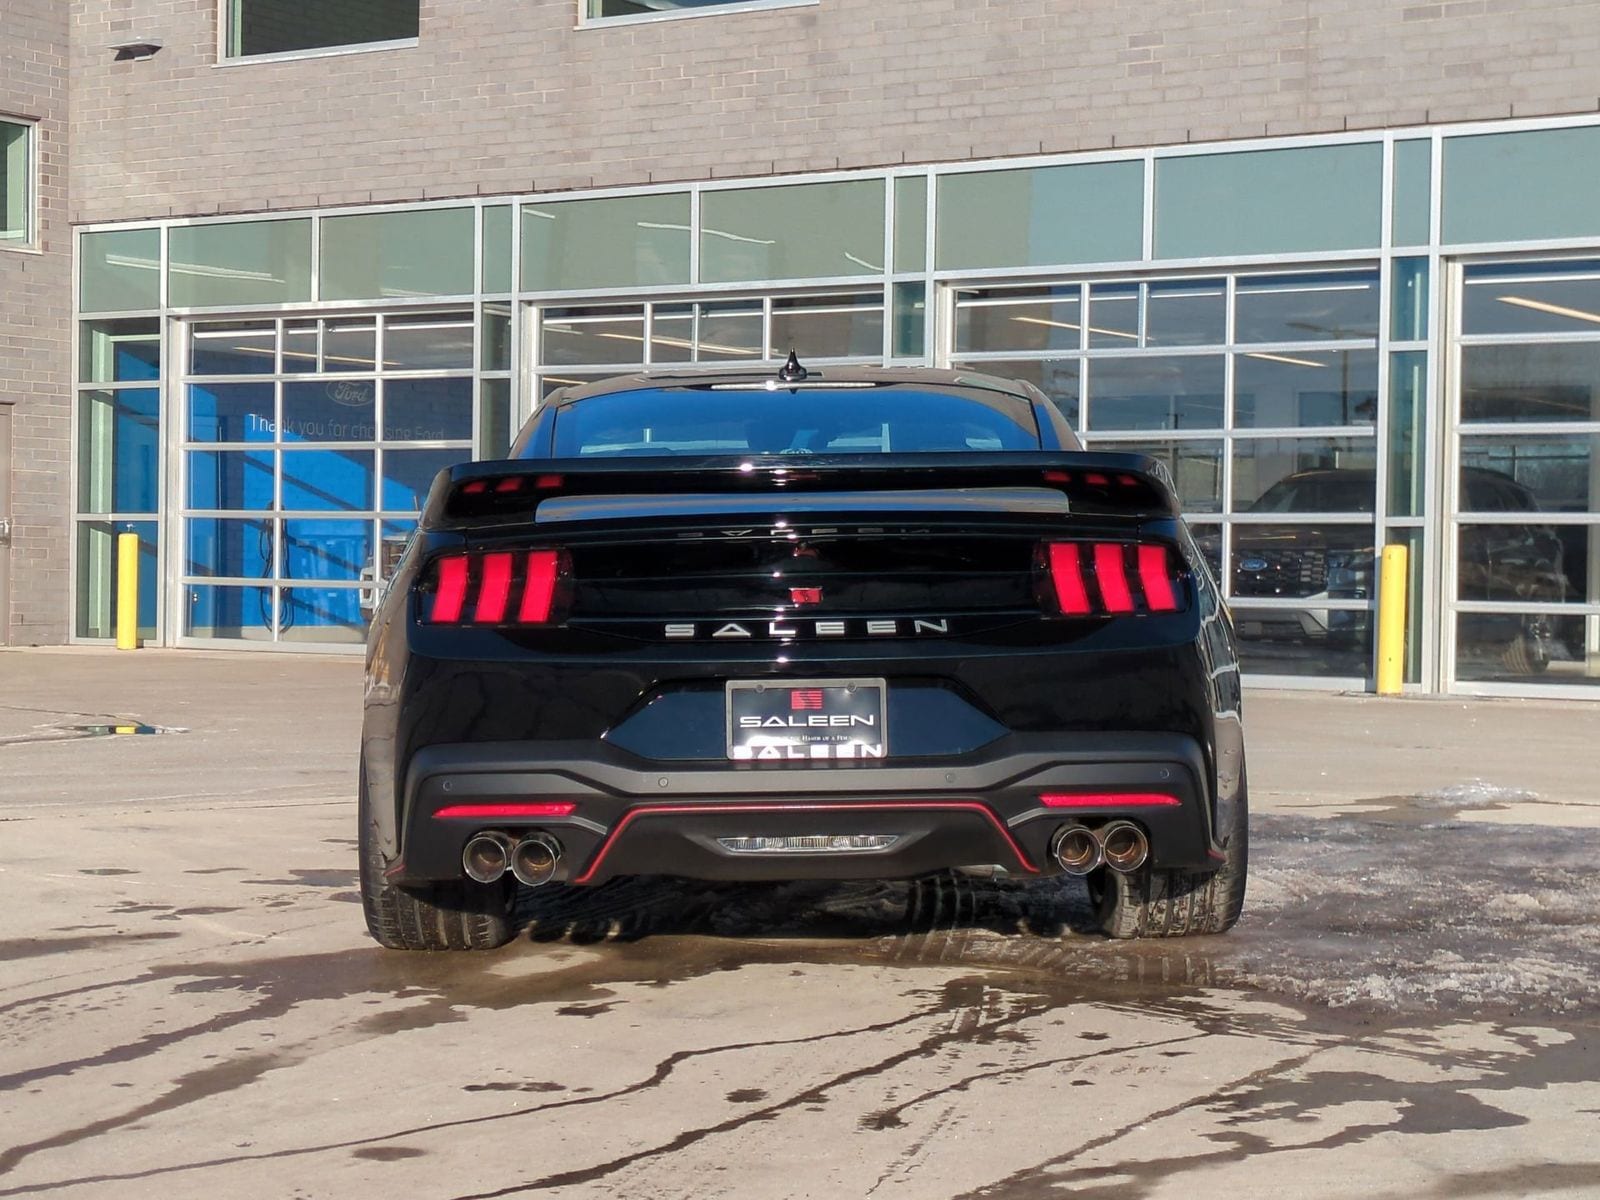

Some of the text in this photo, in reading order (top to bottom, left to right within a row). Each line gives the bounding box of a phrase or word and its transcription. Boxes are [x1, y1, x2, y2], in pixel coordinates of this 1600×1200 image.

[334, 382, 370, 401] Ford
[300, 421, 324, 436] you
[328, 419, 347, 437] for
[351, 421, 411, 440] chosing
[665, 619, 948, 638] SALEEN
[739, 715, 874, 728] SALEEN
